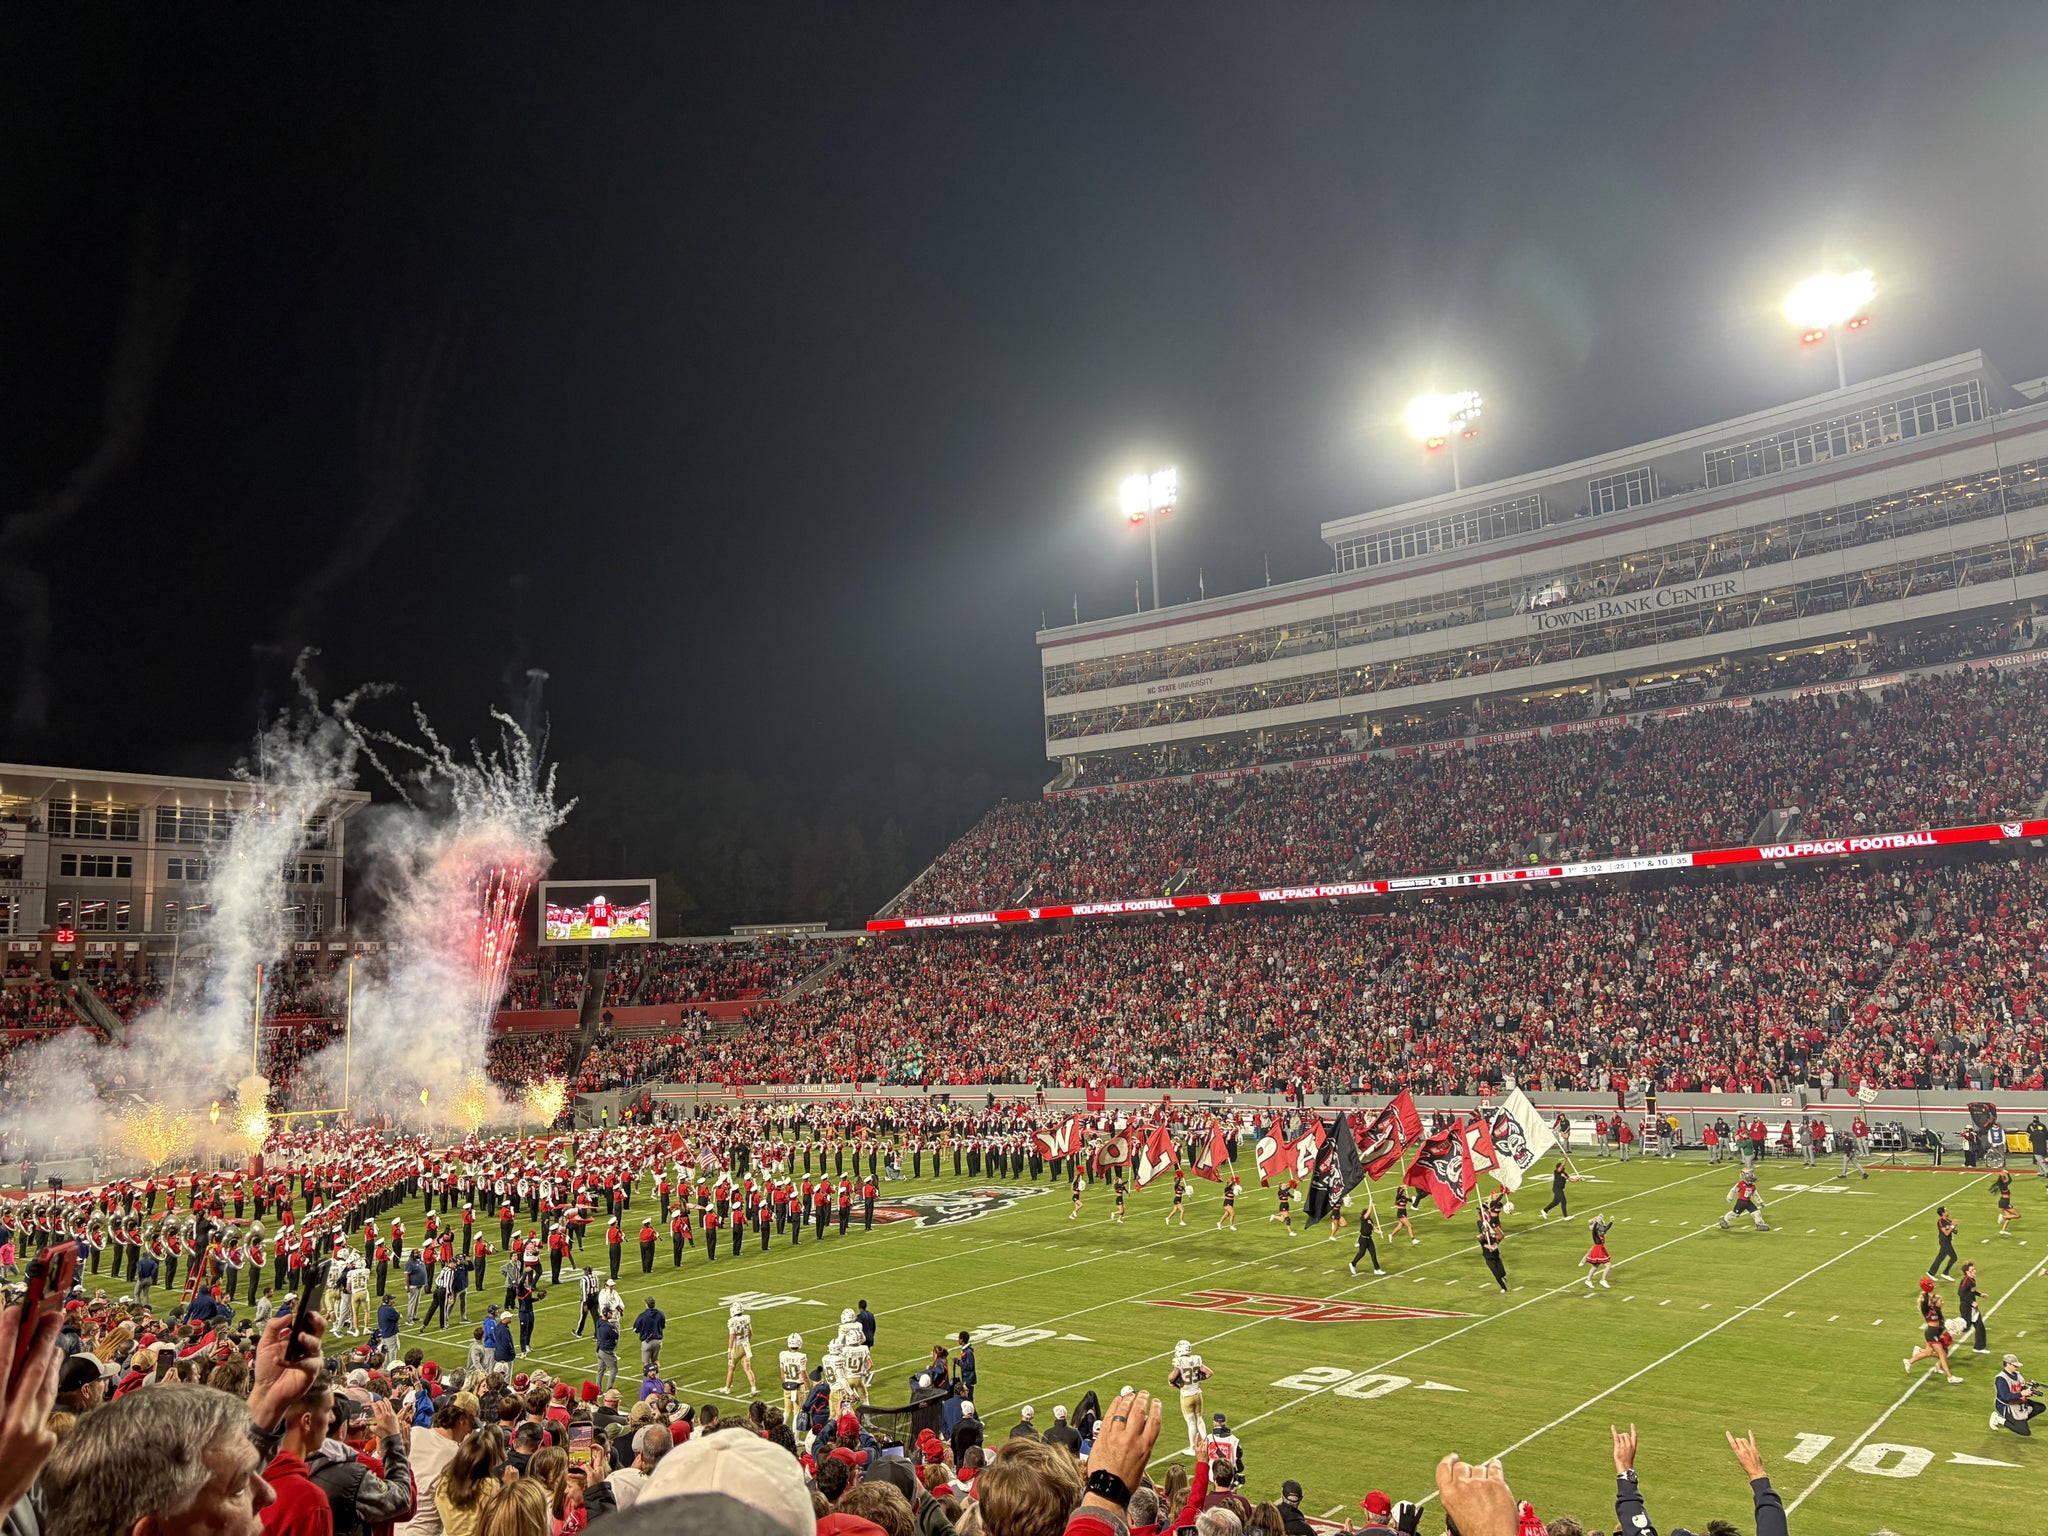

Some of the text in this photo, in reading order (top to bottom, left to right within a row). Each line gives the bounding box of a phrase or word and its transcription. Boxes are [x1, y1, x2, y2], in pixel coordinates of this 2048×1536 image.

[1656, 579, 1738, 607] CENTER
[1987, 654, 2028, 667] TORRY
[1147, 677, 1213, 694] NC STATE UNIVERSITY
[1567, 717, 1620, 732] DENNIS BYRD
[1489, 729, 1534, 743] TED BROWN
[1434, 741, 1457, 750] YOEST
[1308, 754, 1361, 768] OMAN GABRIEL
[1204, 771, 1229, 780] PAYTON
[1759, 832, 1937, 859] WOLFPACK FOOTBALL
[1582, 865, 1603, 873] 3:52
[1657, 858, 1669, 867] 10
[1676, 857, 1688, 865] 35
[1258, 887, 1318, 901] WOLFPACK
[1319, 883, 1378, 897] FOOTBALL
[1072, 899, 1175, 915] WOLFPACK FOOTBALL
[904, 912, 998, 928] WOLFPACK FOOTBALL
[57, 930, 75, 942] 25
[766, 1084, 841, 1094] WAYNE DAY FAMILY FIELD
[1780, 1097, 1793, 1107] 22
[1036, 1118, 1075, 1158] W
[1136, 1143, 1173, 1187] L
[1255, 1136, 1279, 1179] P
[944, 1323, 1058, 1347] 30
[783, 1363, 799, 1380] 40
[1182, 1367, 1200, 1386] 33
[1269, 1366, 1413, 1399] 20
[1783, 1431, 1937, 1478] 10
